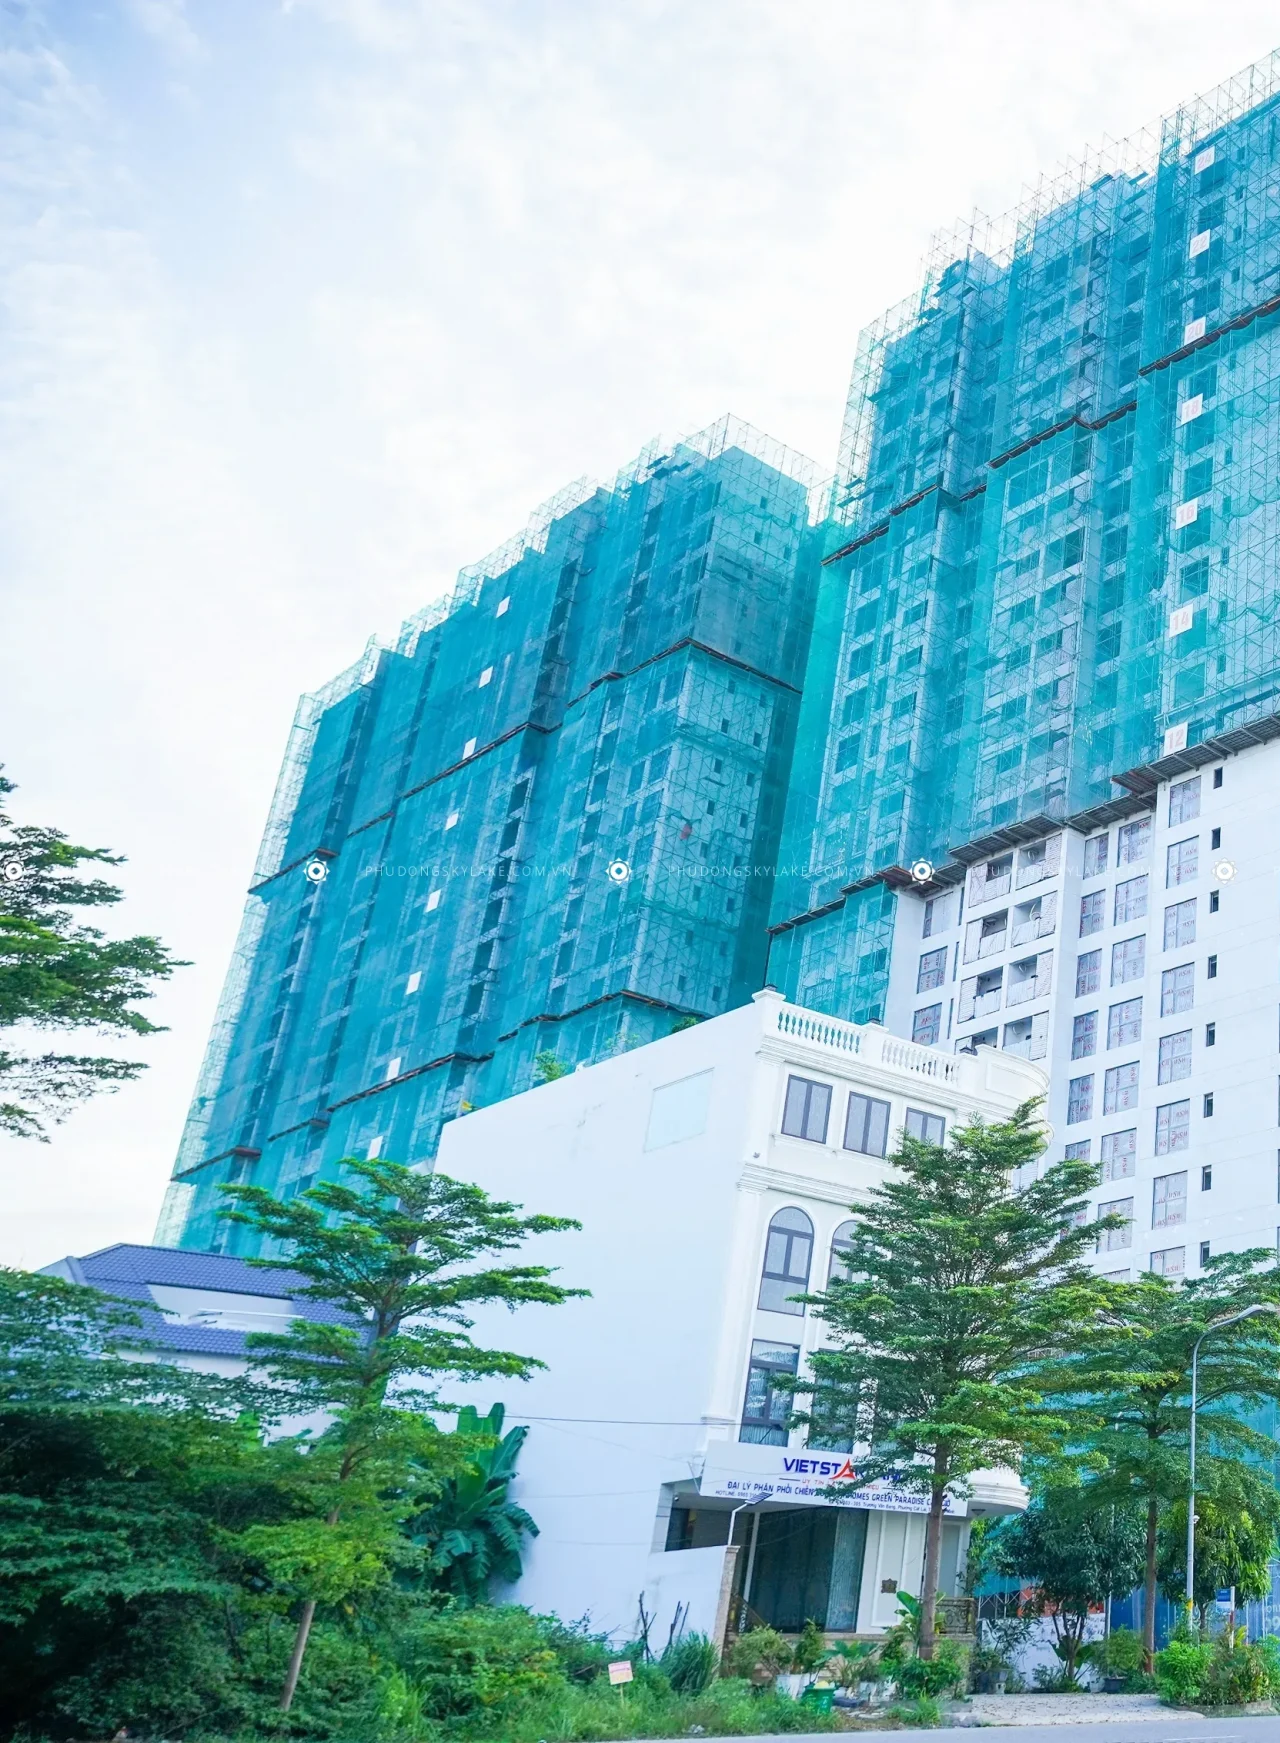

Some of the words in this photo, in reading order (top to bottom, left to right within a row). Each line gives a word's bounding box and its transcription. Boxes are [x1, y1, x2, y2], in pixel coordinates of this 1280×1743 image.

[1184, 399, 1200, 417] 18
[1179, 504, 1195, 523] 16
[1173, 612, 1189, 631] 14
[1168, 728, 1184, 749] 12
[742, 1480, 752, 1491] LÝ
[753, 1483, 774, 1492] PHÂN
[872, 1493, 893, 1502] GREEN
[894, 1495, 925, 1505] PARADISE
